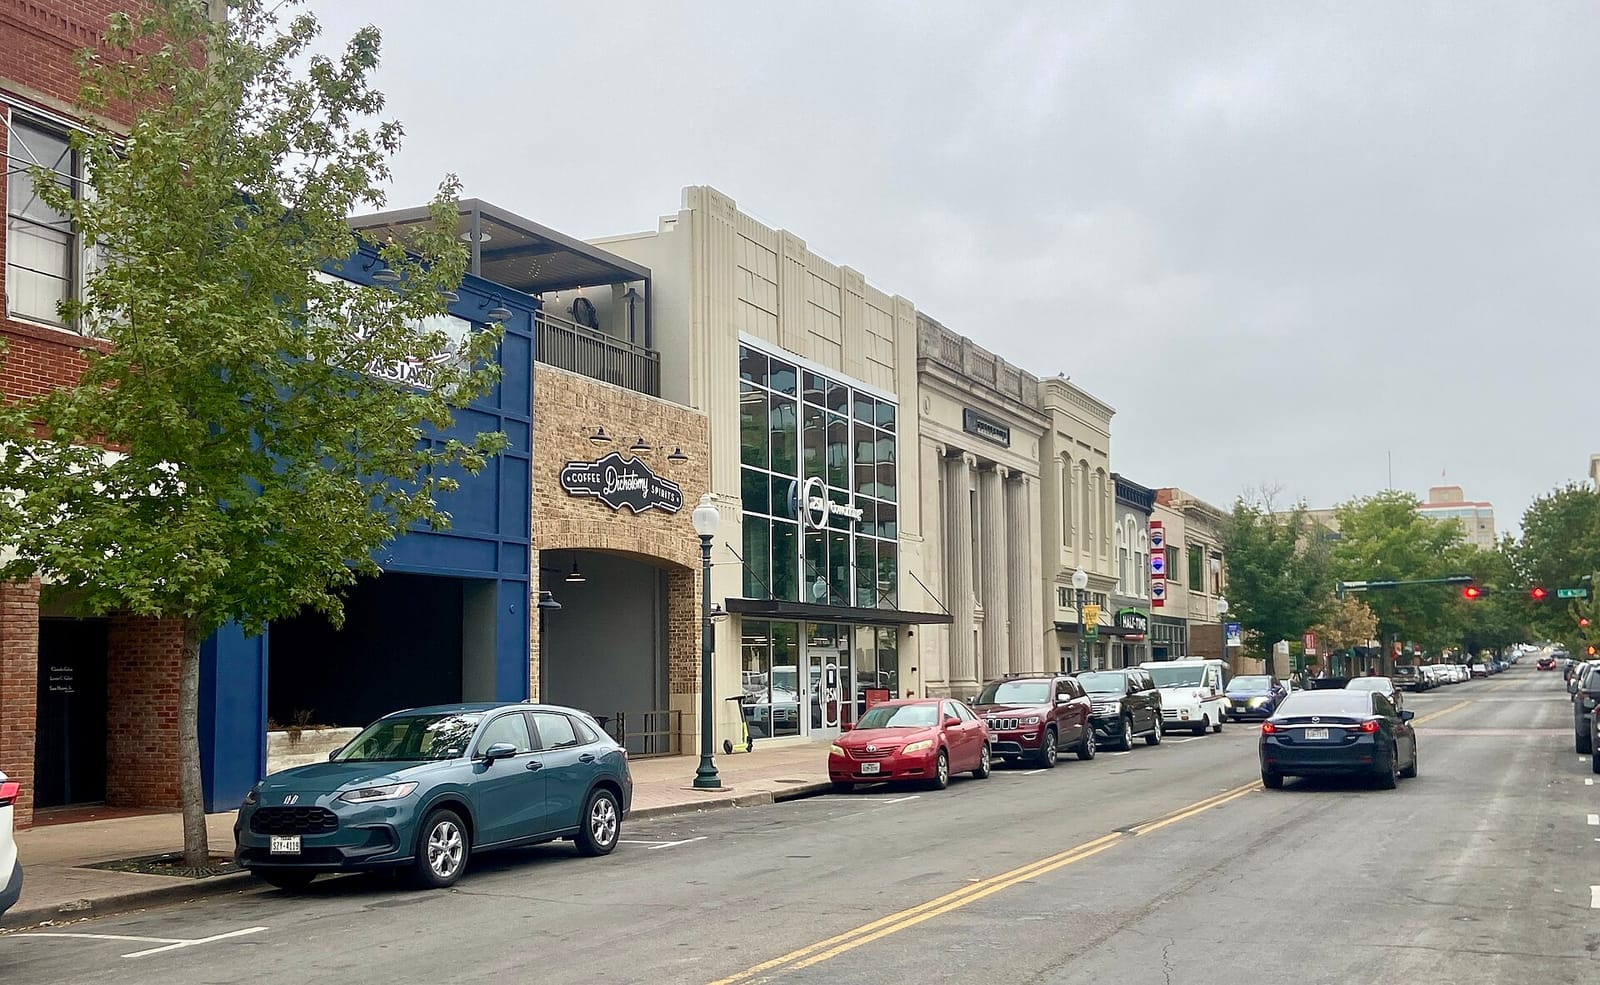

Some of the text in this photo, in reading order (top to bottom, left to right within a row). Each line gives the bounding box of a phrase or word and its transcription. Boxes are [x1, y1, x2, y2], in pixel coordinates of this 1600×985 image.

[572, 466, 675, 502] COFFEE Dichotomy SPIRITS
